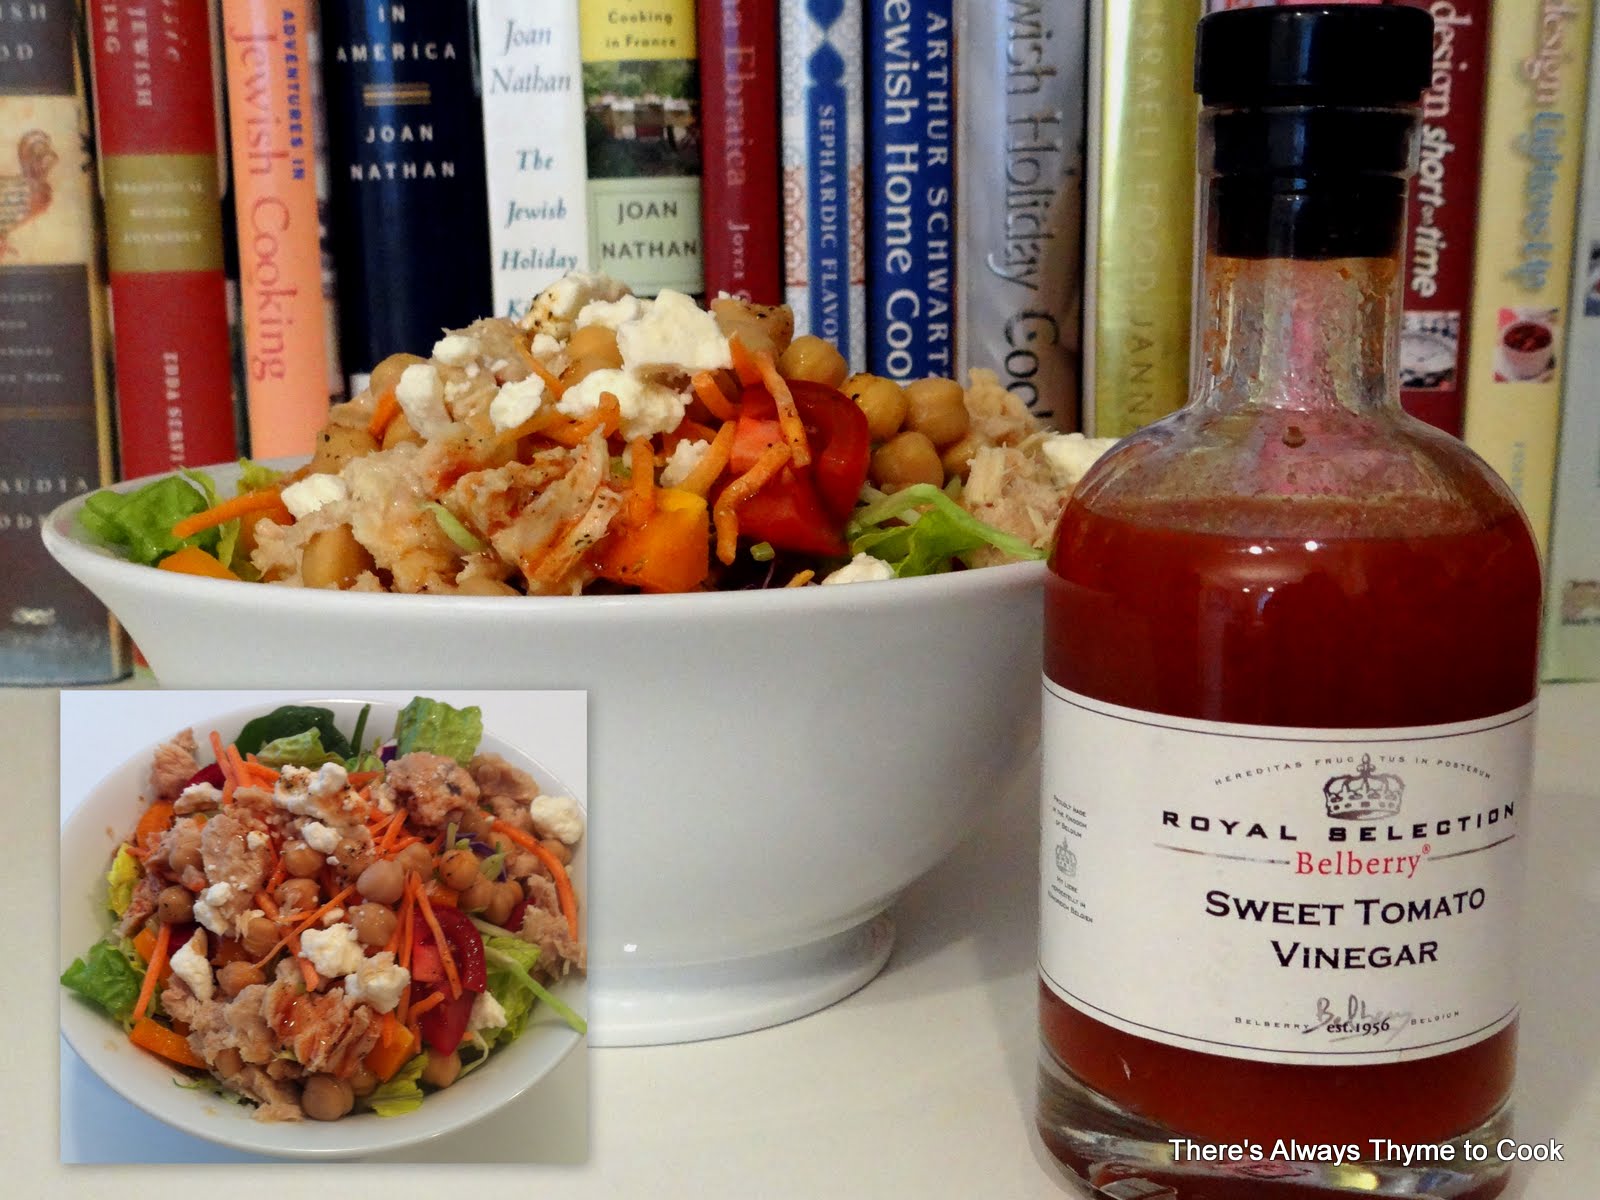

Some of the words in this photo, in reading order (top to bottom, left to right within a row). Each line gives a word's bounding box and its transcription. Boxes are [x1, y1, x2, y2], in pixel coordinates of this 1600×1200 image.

[378, 6, 406, 22] IN
[608, 8, 672, 27] Cooking
[336, 42, 457, 63] AMERICA
[504, 18, 552, 56] Joan
[605, 37, 619, 48] in
[625, 34, 676, 48] France
[127, 6, 153, 107] JEWISH
[282, 9, 304, 149] ADVENTURES
[489, 65, 571, 96] Nathan
[926, 12, 949, 167] ARTHUR
[229, 25, 290, 176] Jewish
[365, 123, 434, 143] JOAN
[292, 157, 305, 181] IN
[350, 160, 456, 181] NATHAN
[517, 148, 554, 171] The
[1417, 123, 1455, 208] short
[819, 105, 837, 249] SEPHARDIC
[505, 200, 568, 228] Jewish
[617, 200, 678, 225] JOAN
[885, 144, 919, 275] Home
[988, 114, 1061, 291] Holiday
[500, 248, 578, 272] Holiday
[602, 241, 698, 260] NATHAN
[1411, 225, 1448, 299] time
[250, 197, 299, 382] Cooking
[886, 288, 920, 390] Coo
[1129, 319, 1154, 413] JANN
[1214, 761, 1302, 786] HEREDITAS
[1415, 757, 1428, 765] IN
[1436, 758, 1491, 779] POSTERUM
[1162, 810, 1298, 842] ROYAL
[1328, 801, 1515, 842] SELECTION
[1206, 890, 1344, 926] SWEET
[1355, 888, 1486, 926] TOMATO
[1271, 940, 1439, 970] VINEGAR
[1234, 1016, 1309, 1029] BELBERRY
[1410, 1011, 1460, 1026] BELGIUM
